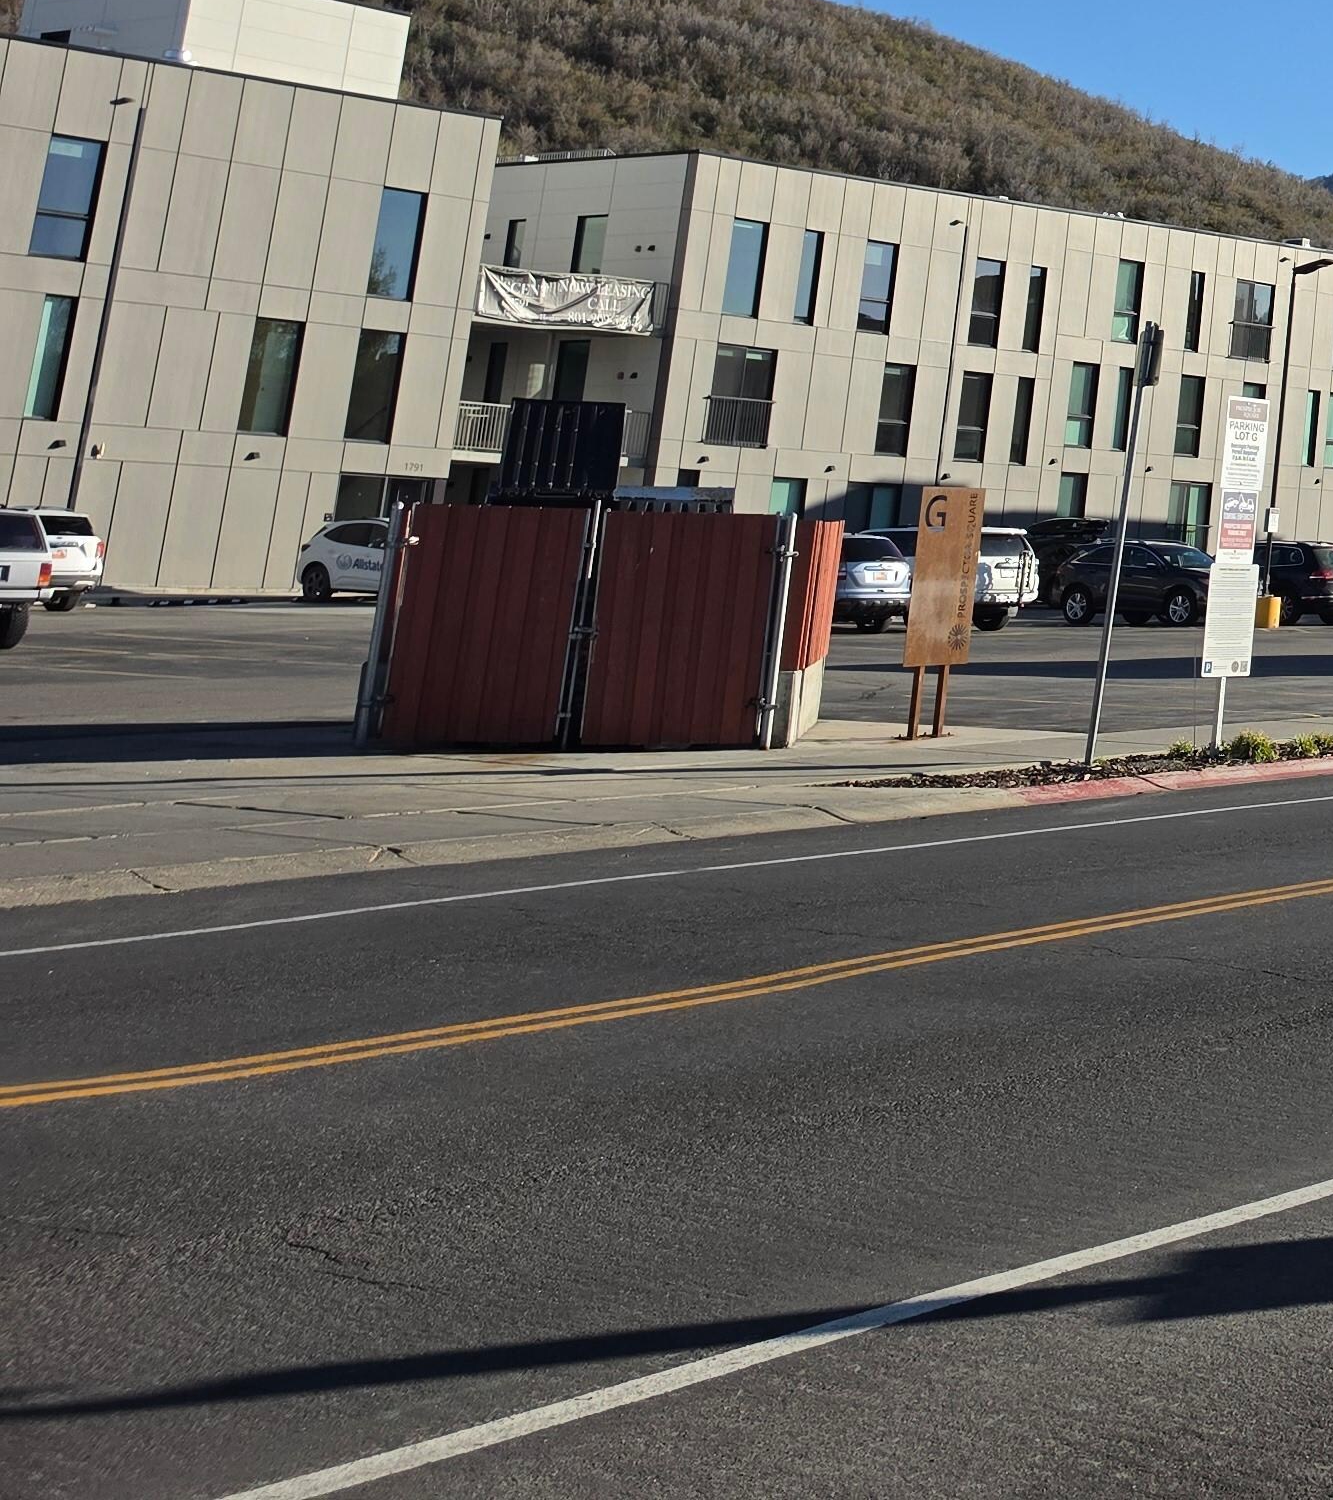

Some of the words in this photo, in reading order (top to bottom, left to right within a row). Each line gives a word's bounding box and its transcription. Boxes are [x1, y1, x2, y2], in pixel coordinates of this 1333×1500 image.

[558, 278, 596, 294] NOW
[596, 280, 651, 299] LEASING
[587, 298, 619, 311] CALL
[1229, 420, 1265, 433] PARKING
[1235, 431, 1250, 441] LOT
[1251, 432, 1258, 442] G
[404, 462, 424, 472] 1791
[925, 494, 948, 532] G
